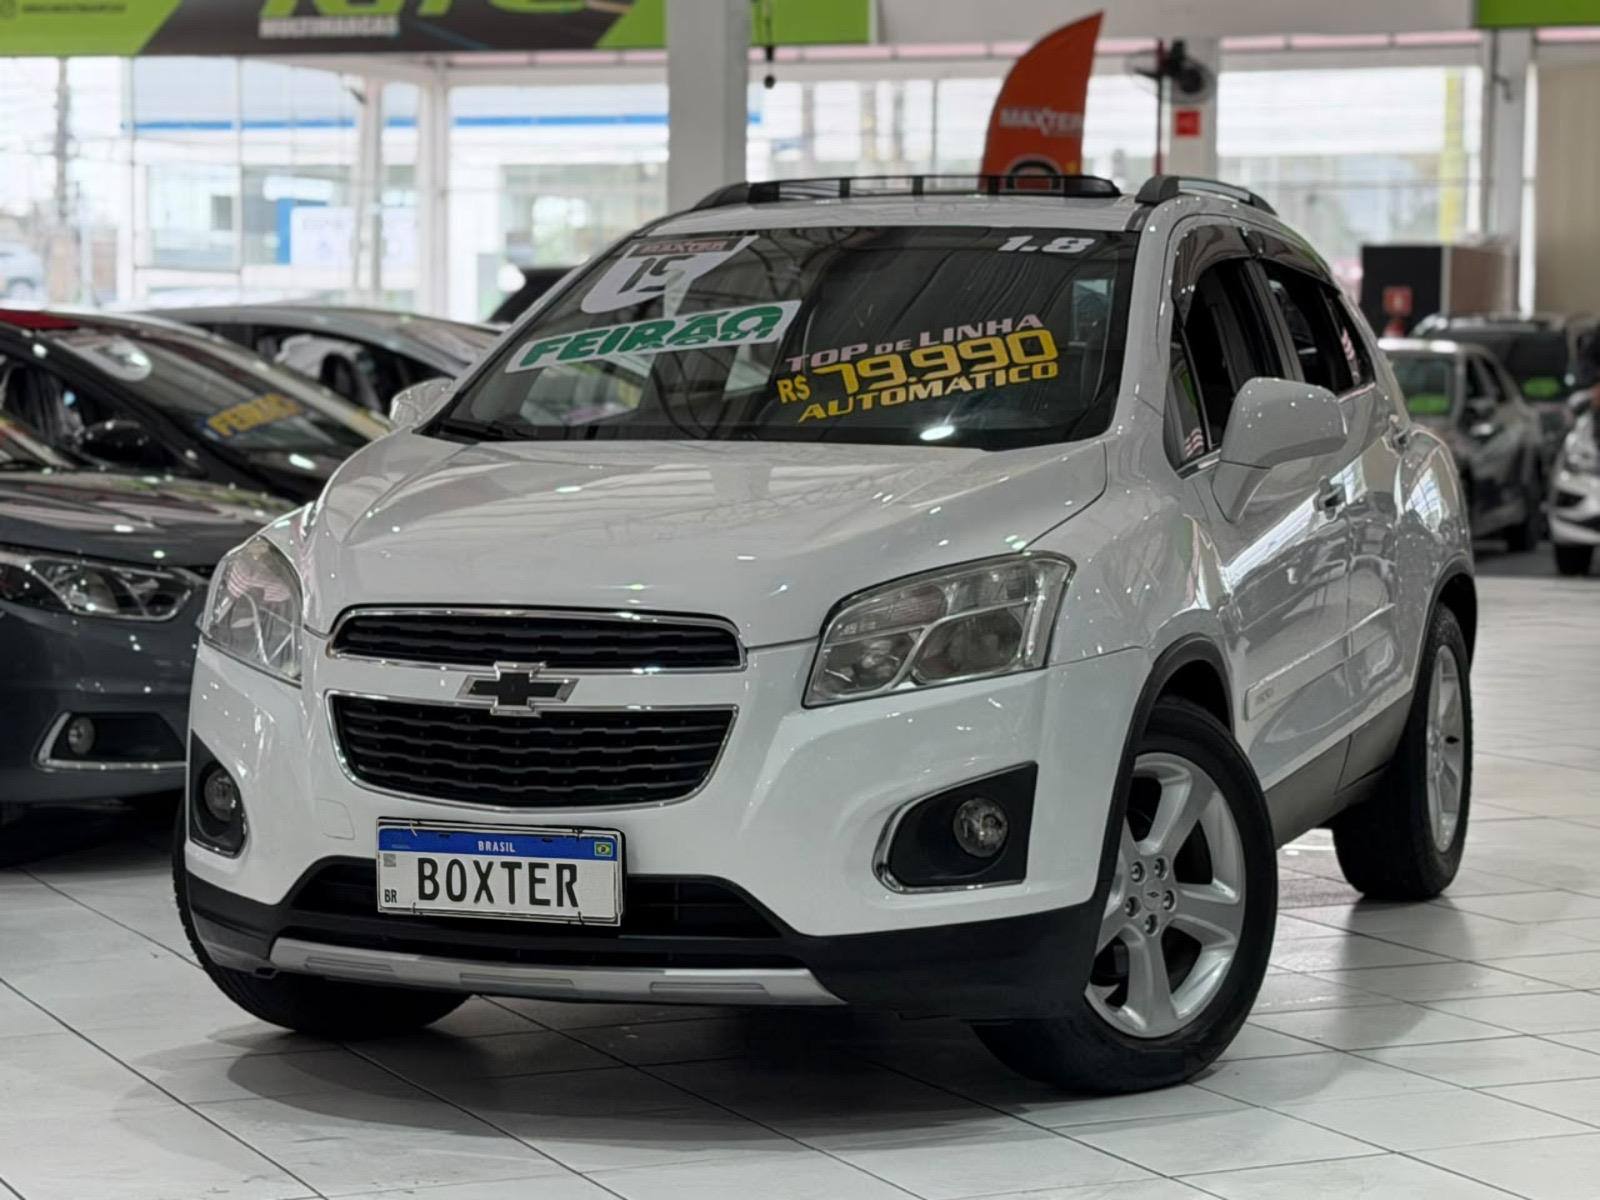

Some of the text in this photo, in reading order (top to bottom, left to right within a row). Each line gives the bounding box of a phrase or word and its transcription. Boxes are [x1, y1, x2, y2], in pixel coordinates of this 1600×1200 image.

[998, 235, 1095, 253] 1.8
[786, 313, 1043, 372] TOP DE LINHA
[812, 328, 1059, 396] 79.990
[477, 840, 516, 853] BRASIL
[384, 888, 398, 904] BR
[417, 857, 579, 908] BOXTER
